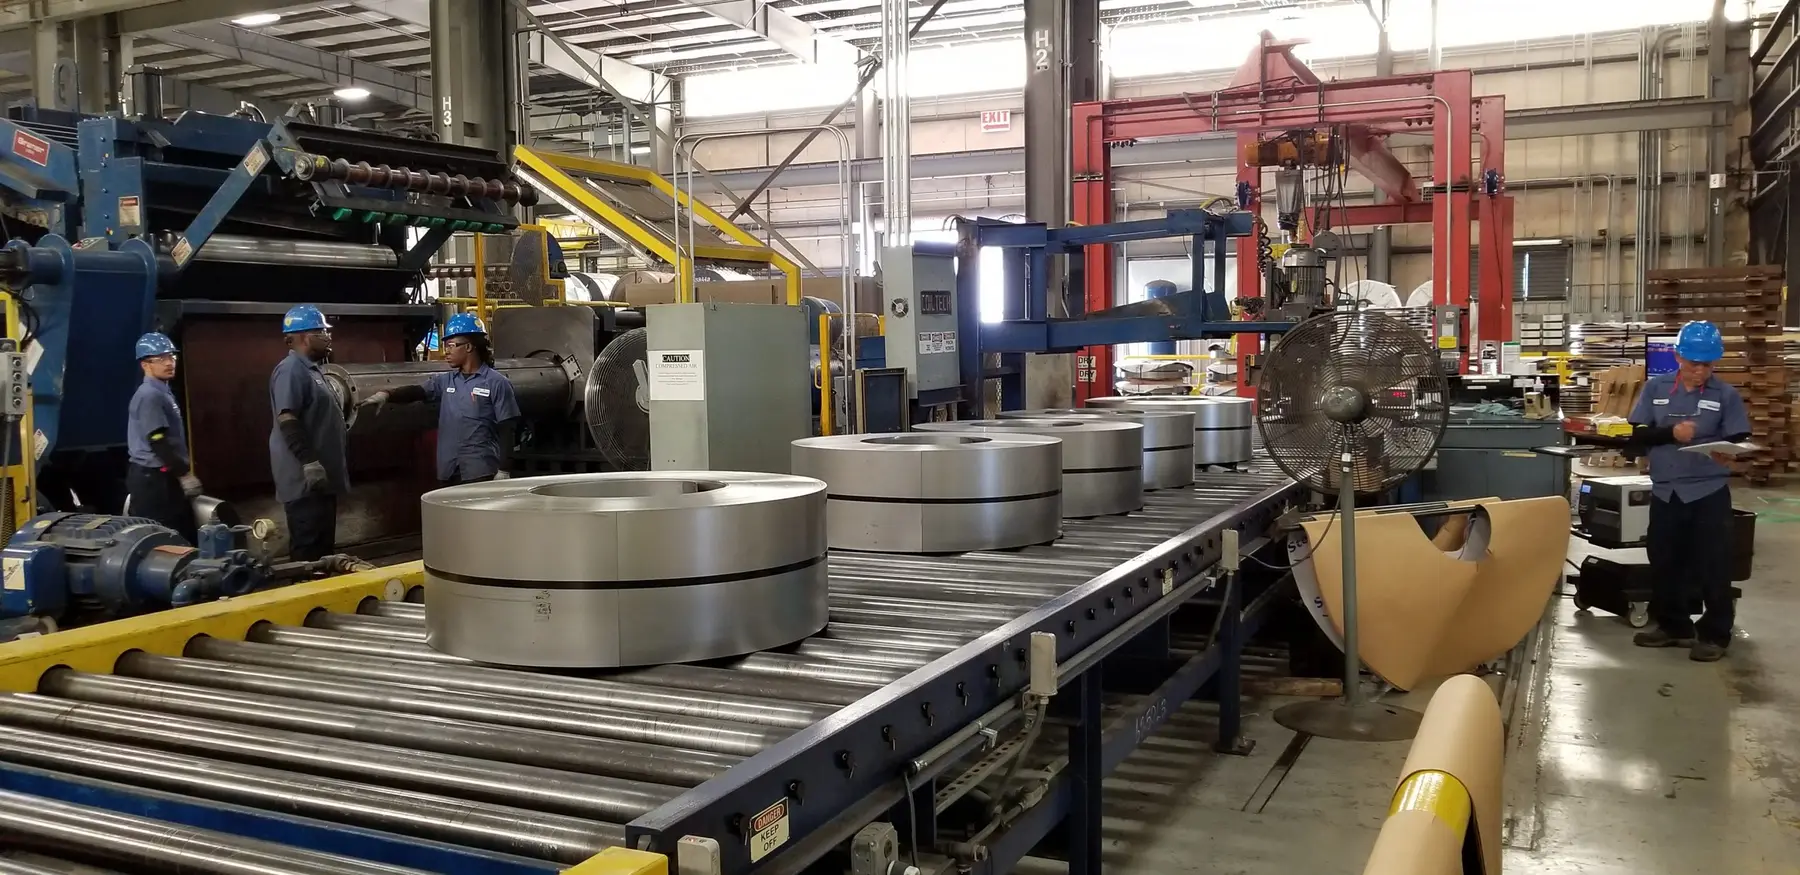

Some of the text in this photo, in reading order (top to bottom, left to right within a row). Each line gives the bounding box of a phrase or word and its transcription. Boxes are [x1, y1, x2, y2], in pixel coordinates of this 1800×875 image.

[982, 111, 1009, 123] EXIT
[662, 354, 690, 362] CAUTION
[757, 807, 781, 829] DANGER
[760, 824, 779, 842] KEEP
[763, 836, 777, 852] OFF
